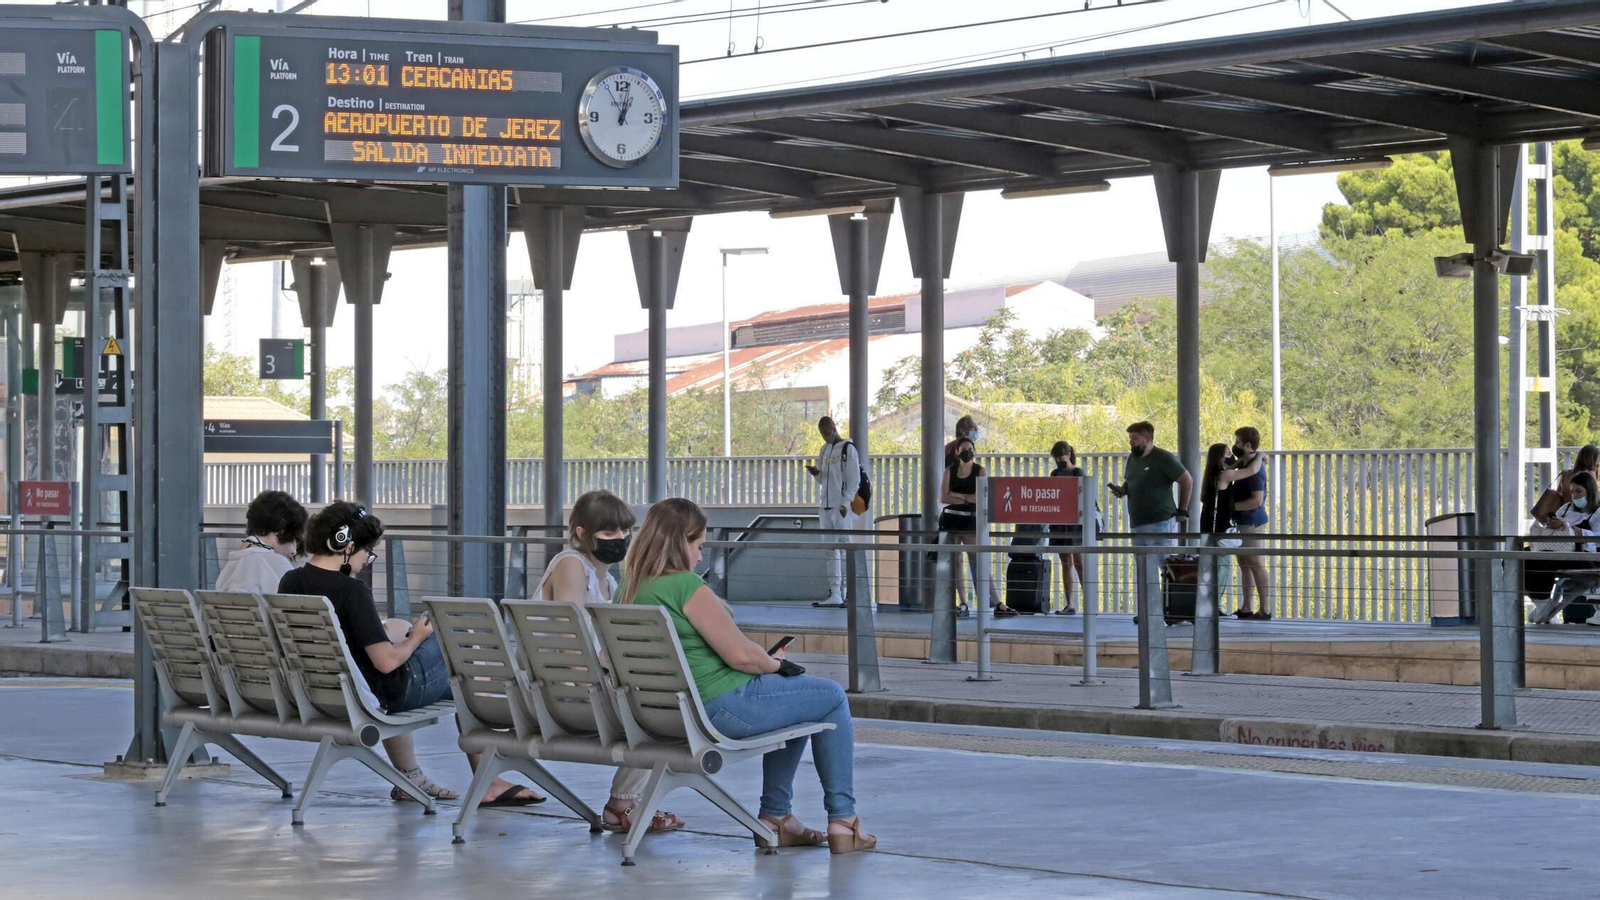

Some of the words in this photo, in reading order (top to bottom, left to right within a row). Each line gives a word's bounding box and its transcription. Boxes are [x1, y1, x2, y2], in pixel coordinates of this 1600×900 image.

[328, 47, 358, 60] Hora
[369, 52, 390, 61] TIME
[405, 51, 433, 63] Tren
[444, 56, 464, 64] TRAIN
[57, 66, 85, 74] PLATFORM
[270, 72, 297, 80] PLATFORM
[326, 63, 389, 86] 13:01
[401, 66, 513, 90] CERCANIAS
[614, 81, 631, 92] 12
[327, 96, 375, 109] Destino
[384, 102, 425, 111] DESTINATION
[589, 111, 599, 123] 9
[643, 112, 653, 124] 3
[270, 104, 299, 152] 2
[324, 112, 450, 136] AEROPUERTO
[462, 116, 487, 138] DE
[499, 118, 561, 141] JEREZ
[352, 140, 429, 164] SALIDA
[441, 143, 552, 168] INMEDIATA
[616, 143, 627, 155] 6
[265, 354, 276, 374] 3
[1020, 485, 1033, 499] No
[1035, 488, 1061, 502] pasar
[1029, 505, 1061, 513] TRESPASSING
[1237, 725, 1262, 745] No
